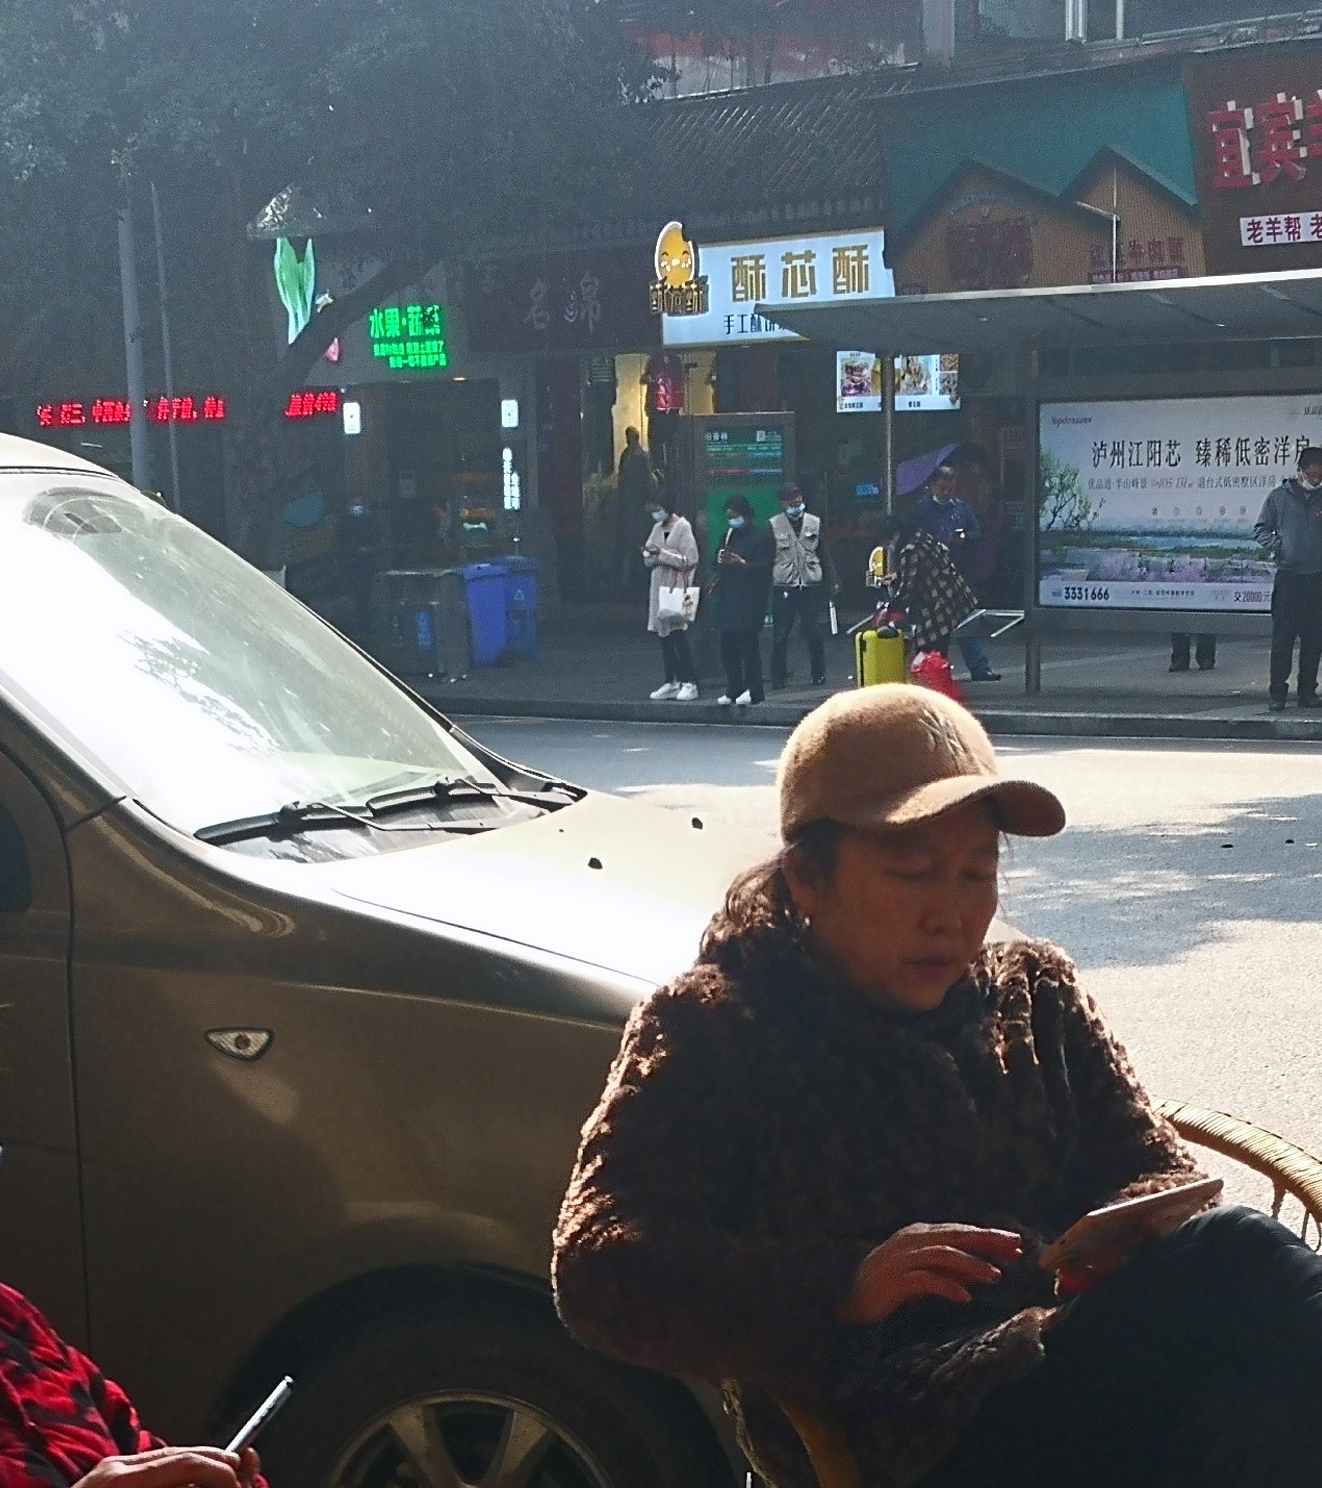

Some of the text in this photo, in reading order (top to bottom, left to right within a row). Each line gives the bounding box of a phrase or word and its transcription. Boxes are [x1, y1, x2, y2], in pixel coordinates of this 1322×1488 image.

[1246, 215, 1302, 245] 老羊帮
[731, 244, 870, 303] 酥芯酥
[1091, 434, 1312, 470] 泸州江阳芯 臻稀低密洋房
[1064, 586, 1110, 601] 3331666
